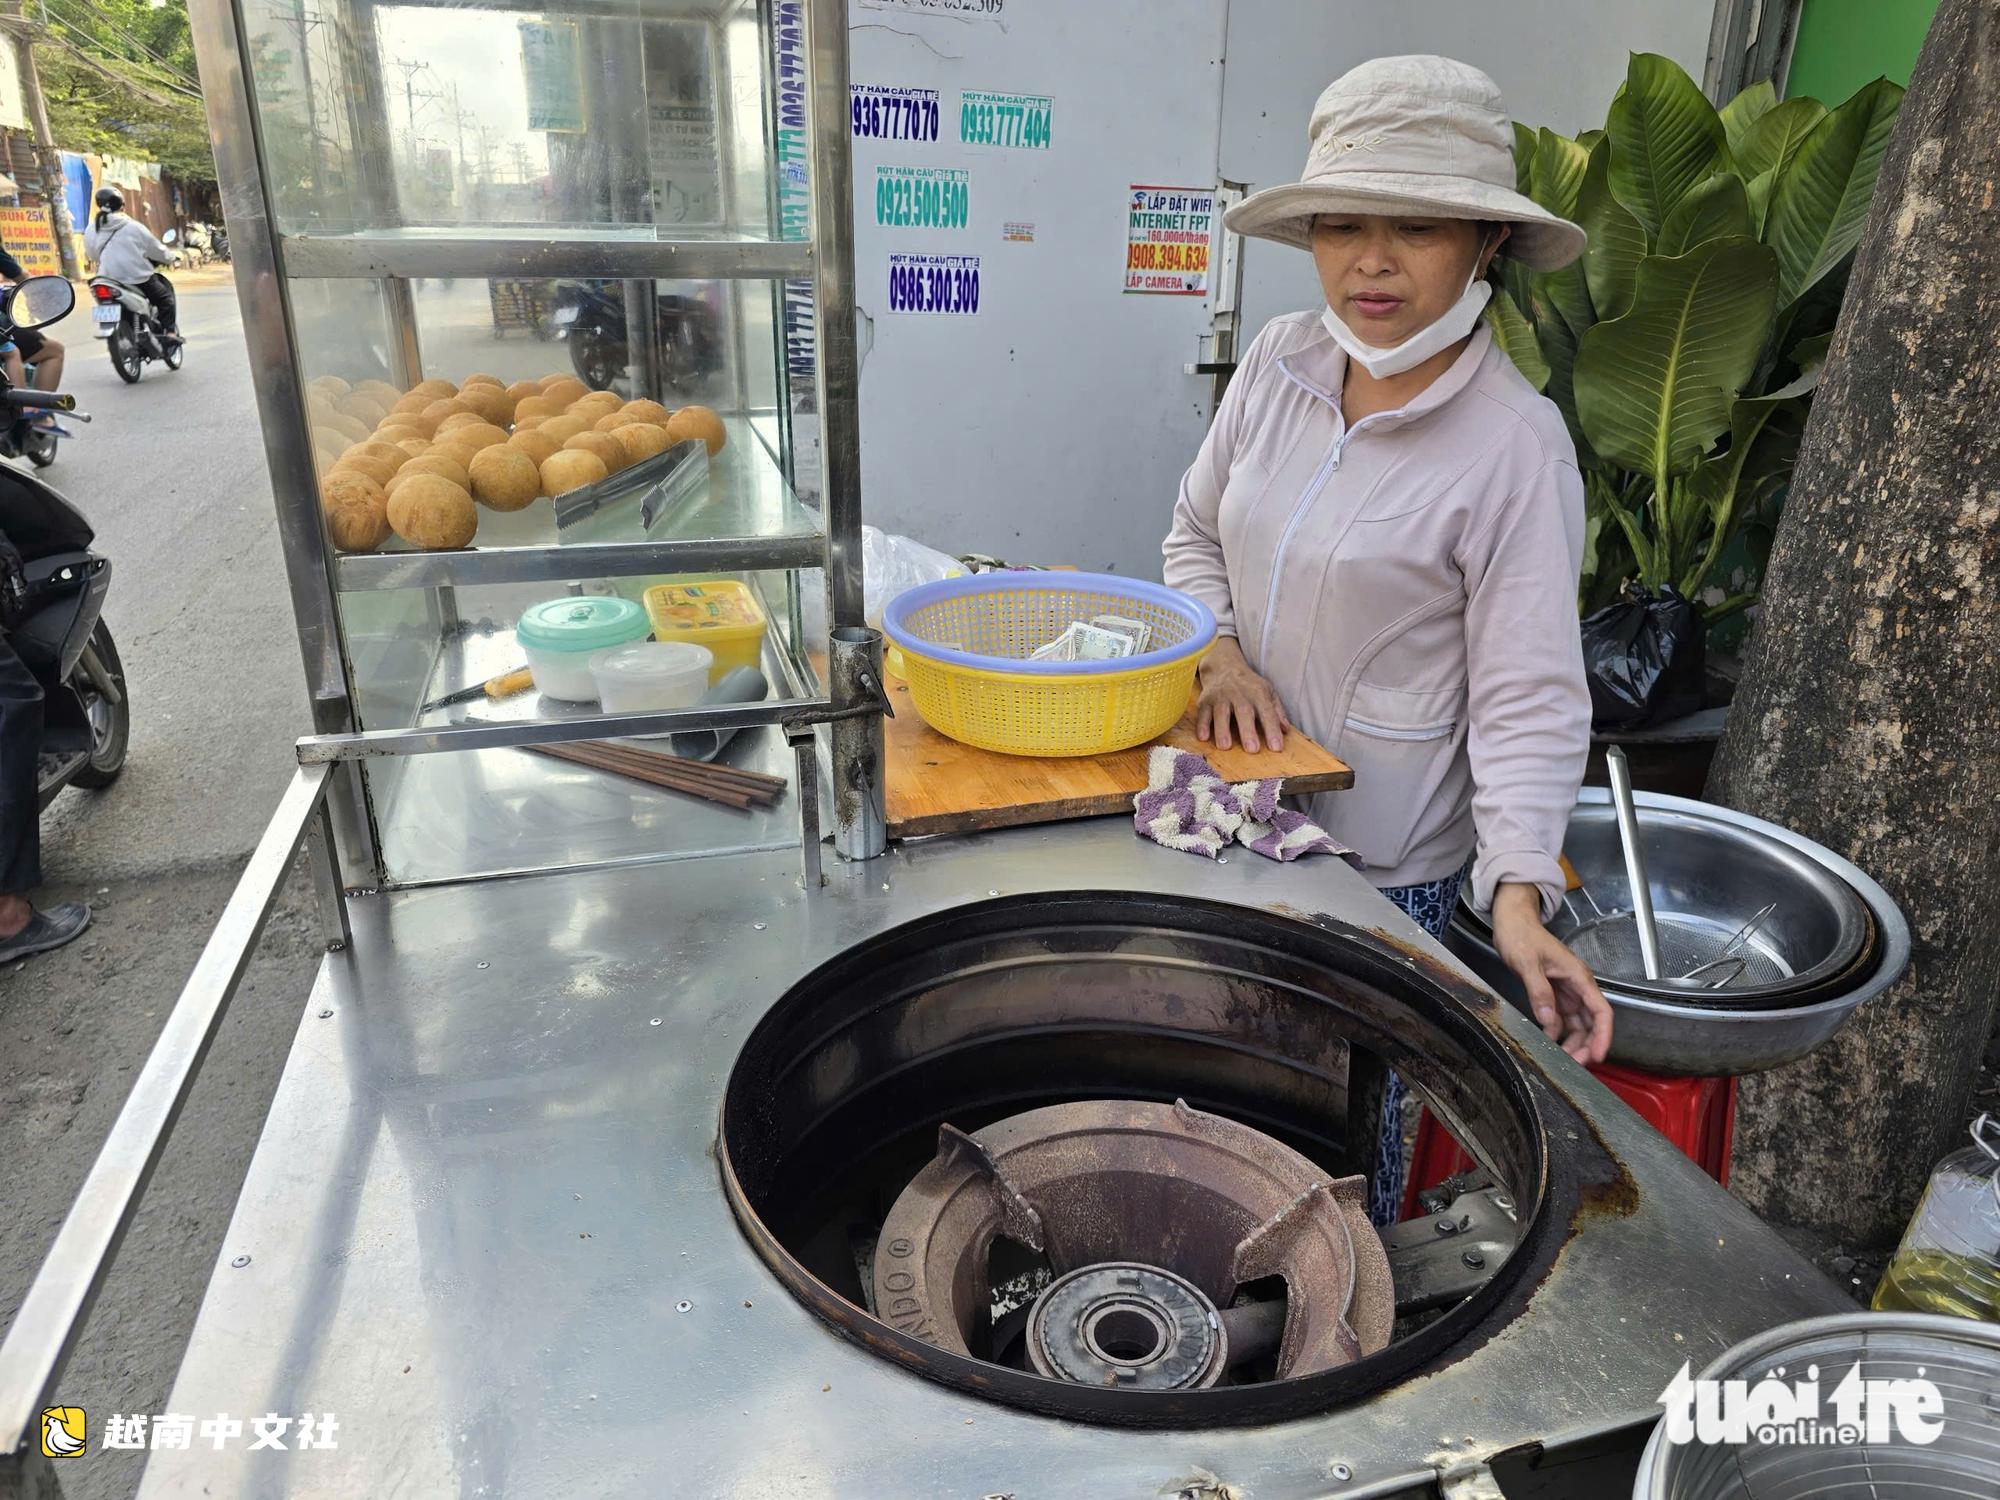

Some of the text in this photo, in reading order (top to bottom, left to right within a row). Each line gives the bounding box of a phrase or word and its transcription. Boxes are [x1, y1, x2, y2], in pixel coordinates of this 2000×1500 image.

[850, 95, 939, 141] 936.77.70.70
[960, 103, 1051, 149] 0933.777.404
[877, 178, 968, 228] 0923.500.500
[1130, 212, 1211, 231] INTERNET FPT
[1191, 198, 1212, 212] WIFI
[890, 265, 979, 314] 0986.300.300
[1145, 276, 1182, 290] CAMERA
